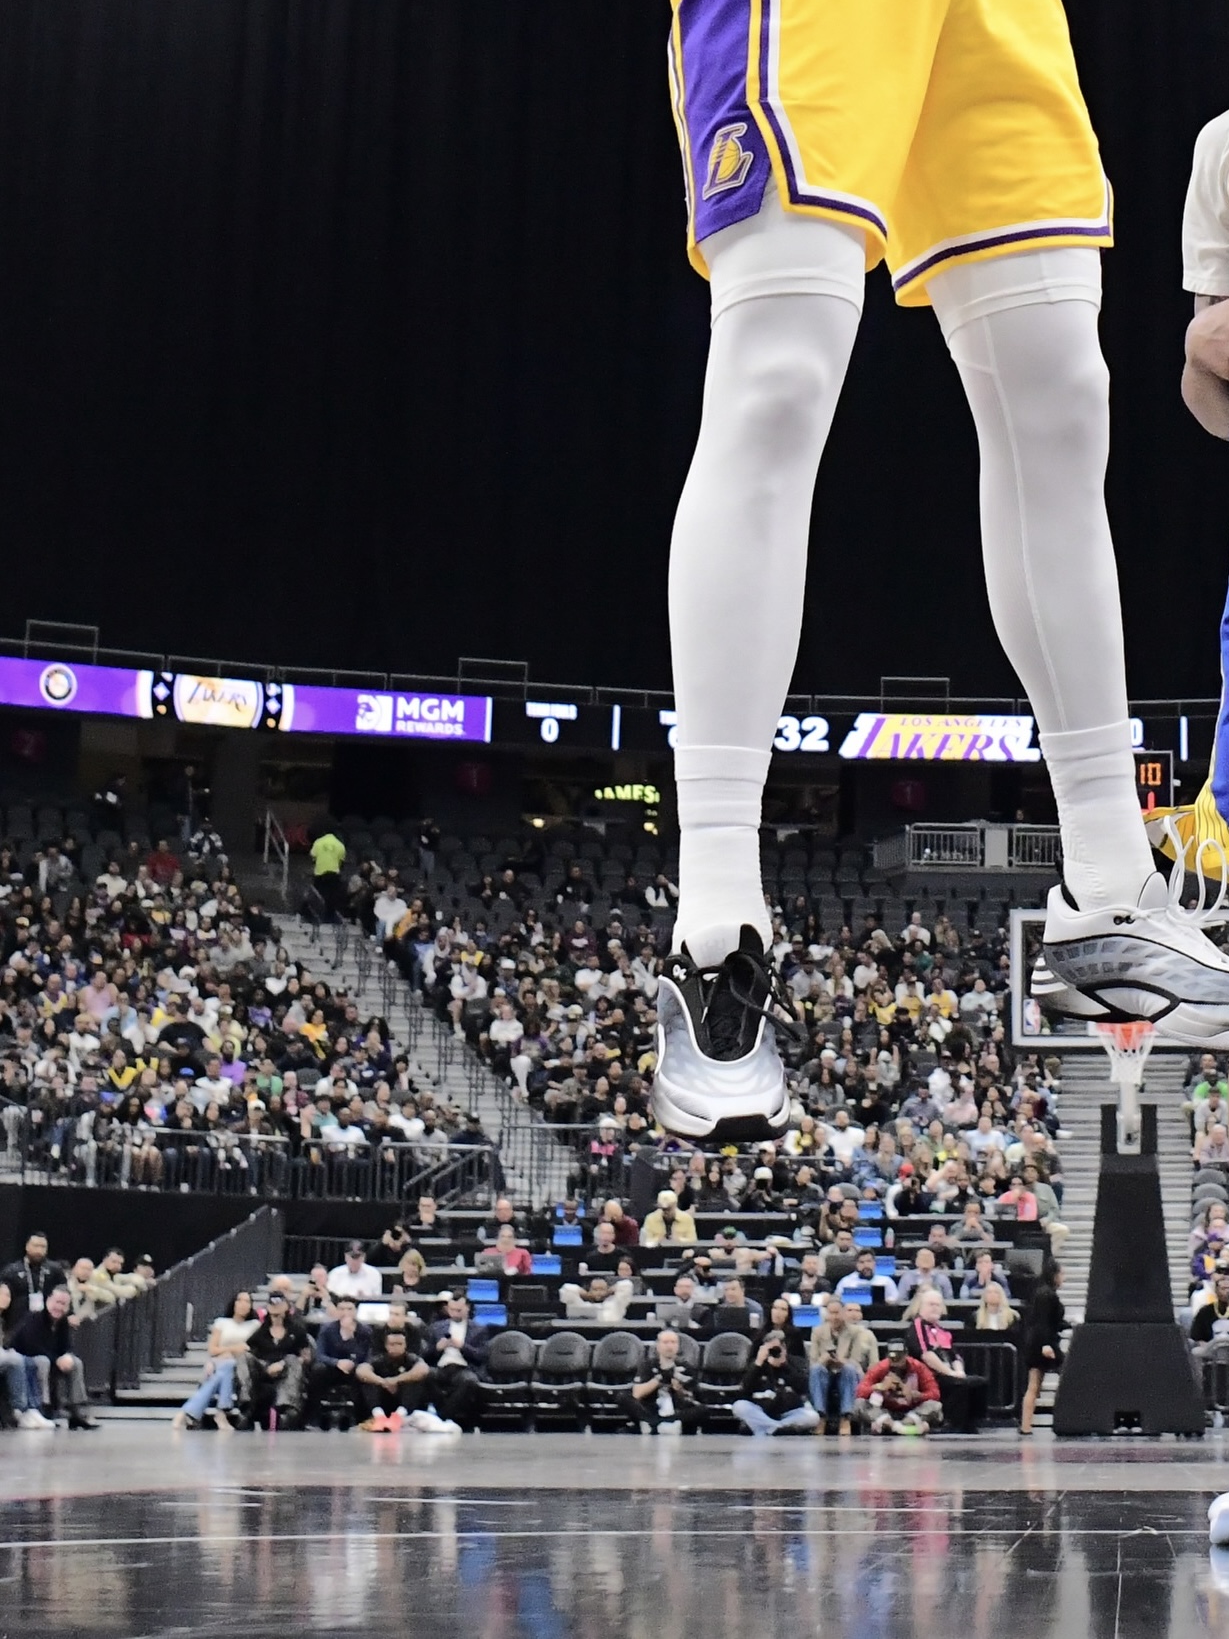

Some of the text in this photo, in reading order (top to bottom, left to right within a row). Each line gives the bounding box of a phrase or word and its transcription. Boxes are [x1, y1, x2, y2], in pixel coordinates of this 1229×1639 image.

[397, 696, 465, 722] MGM
[396, 720, 465, 736] REWARDS
[540, 717, 559, 743] 0
[774, 716, 829, 752] 32
[1140, 763, 1162, 786] 10
